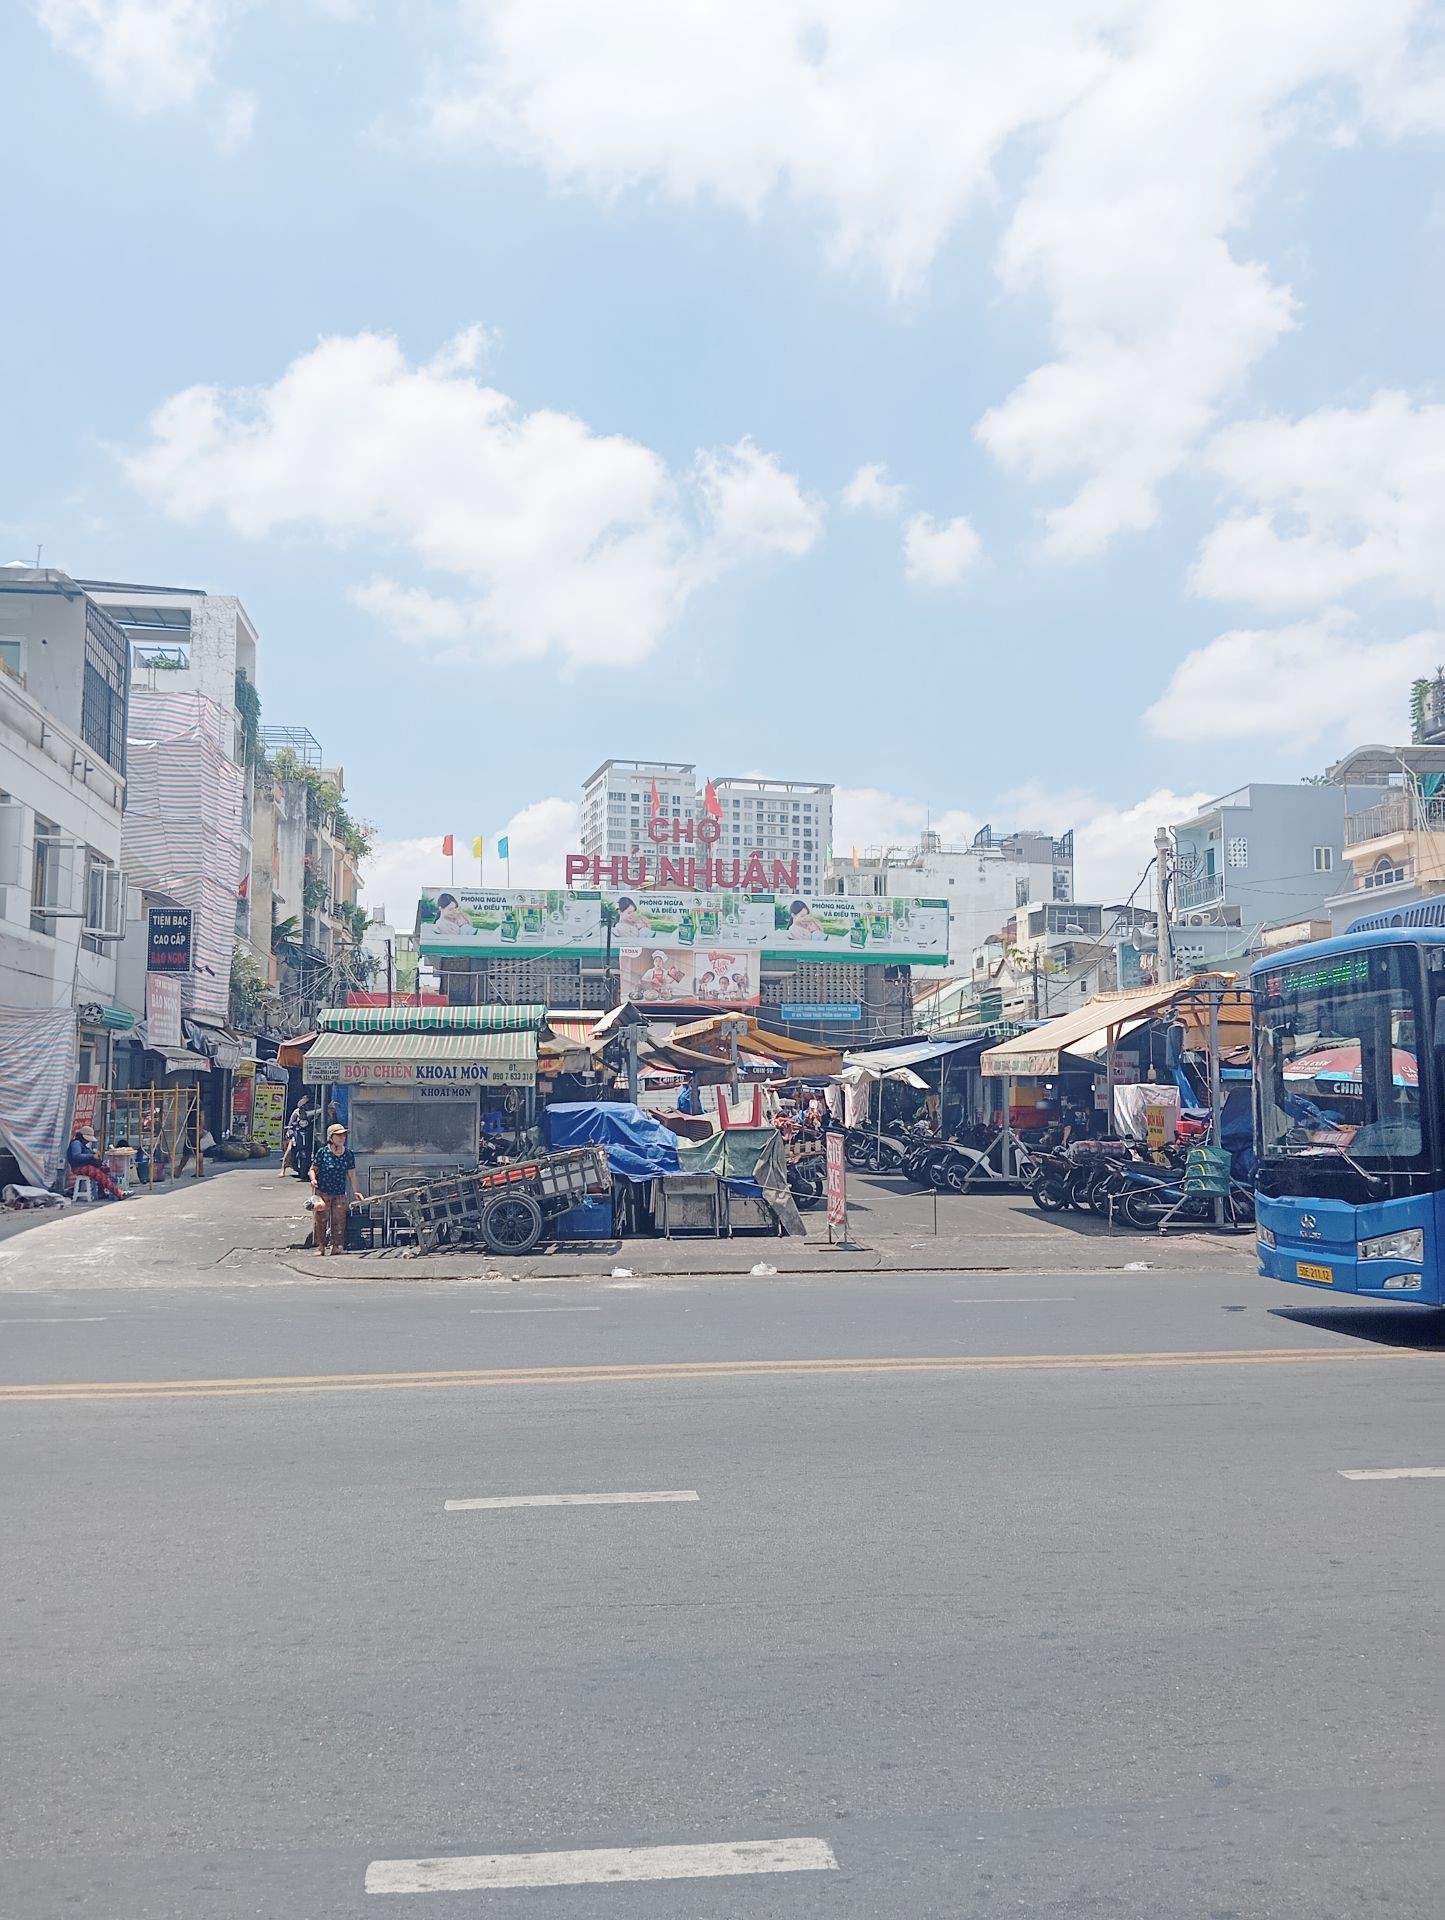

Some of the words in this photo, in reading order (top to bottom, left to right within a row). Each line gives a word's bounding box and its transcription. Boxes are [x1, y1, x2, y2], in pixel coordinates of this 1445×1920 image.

[566, 847, 647, 886] PHÚ
[661, 850, 798, 894] NHUẬN
[152, 913, 171, 929] TIỆM
[172, 915, 188, 929] BẠC
[153, 934, 170, 945] CAO
[170, 931, 186, 945] CẤP
[344, 1061, 370, 1082] BỘT
[373, 1062, 413, 1078] CHIÊN
[415, 1065, 458, 1079] KHOAI
[460, 1062, 489, 1080] MÔN
[420, 1088, 450, 1097] KHOAI
[828, 1167, 840, 1192] XE
